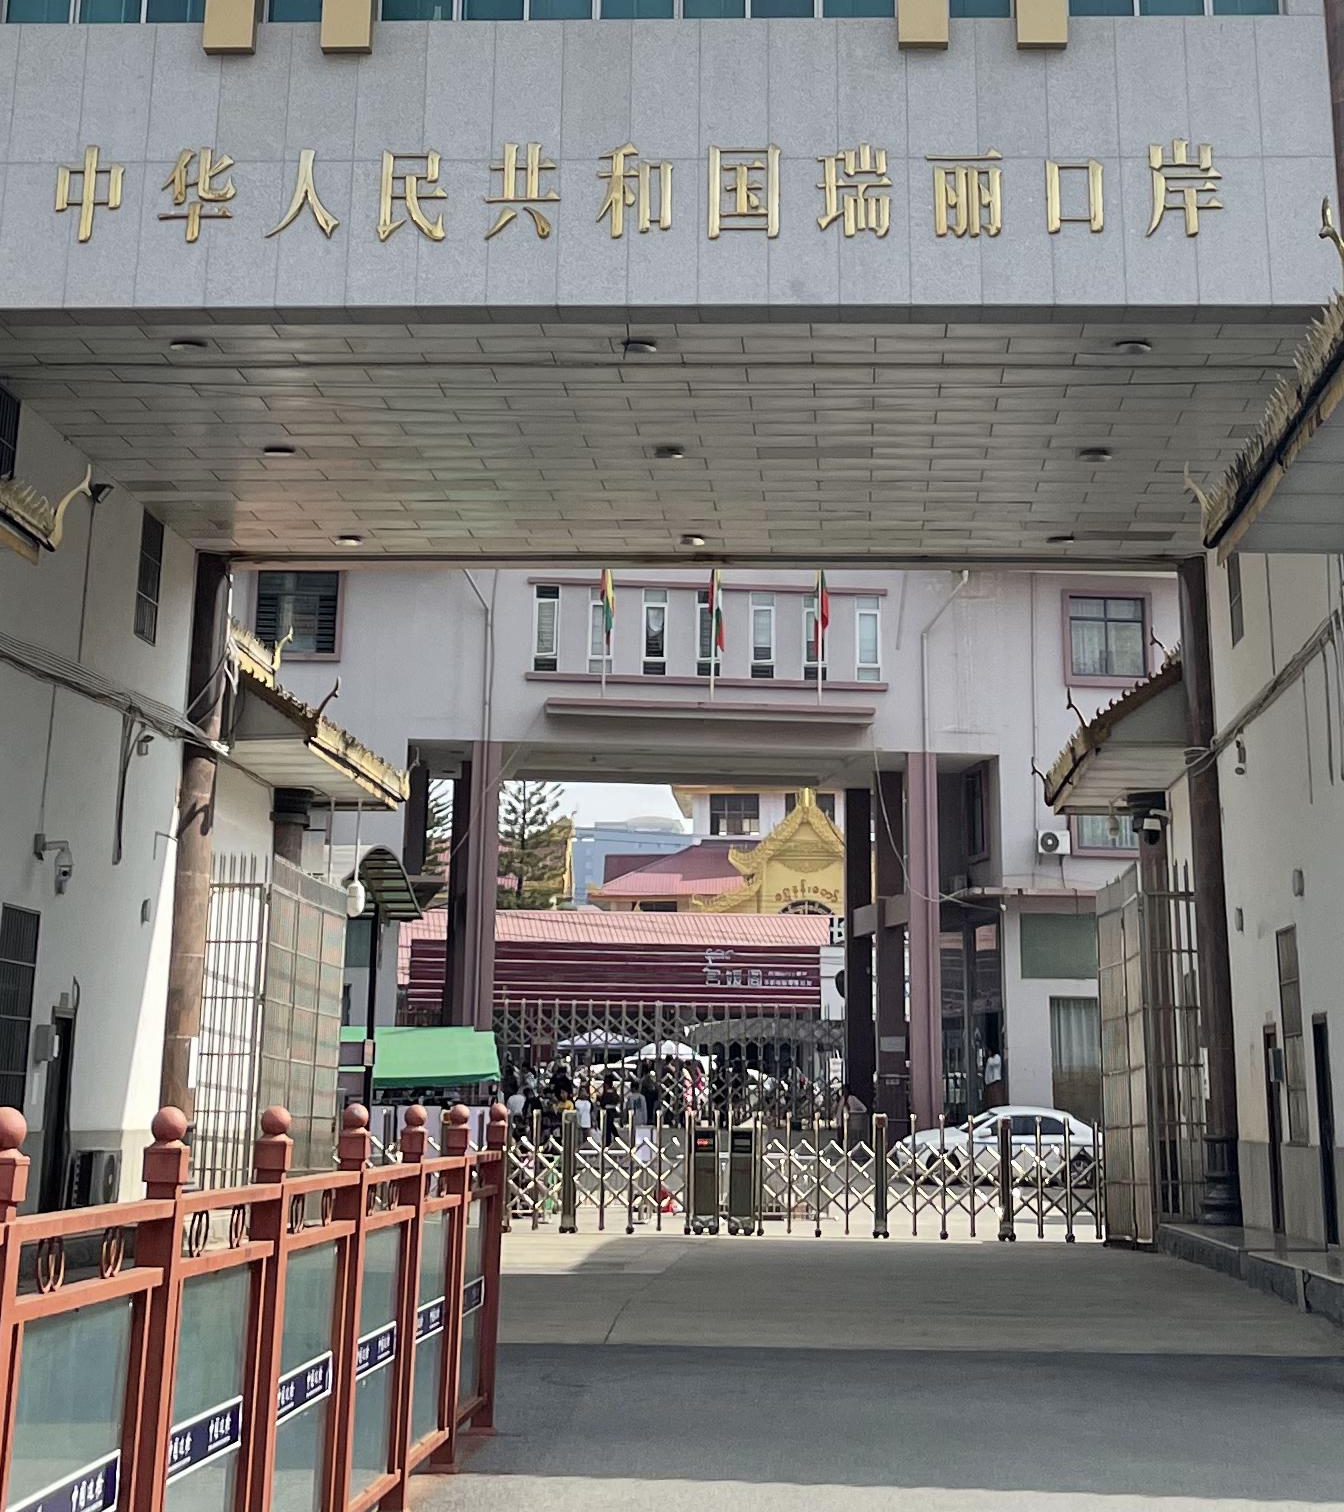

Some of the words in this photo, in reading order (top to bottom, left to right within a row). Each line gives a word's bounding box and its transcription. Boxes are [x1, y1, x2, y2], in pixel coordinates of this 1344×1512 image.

[55, 137, 1225, 244] 中华人民共和国瑞丽口岸
